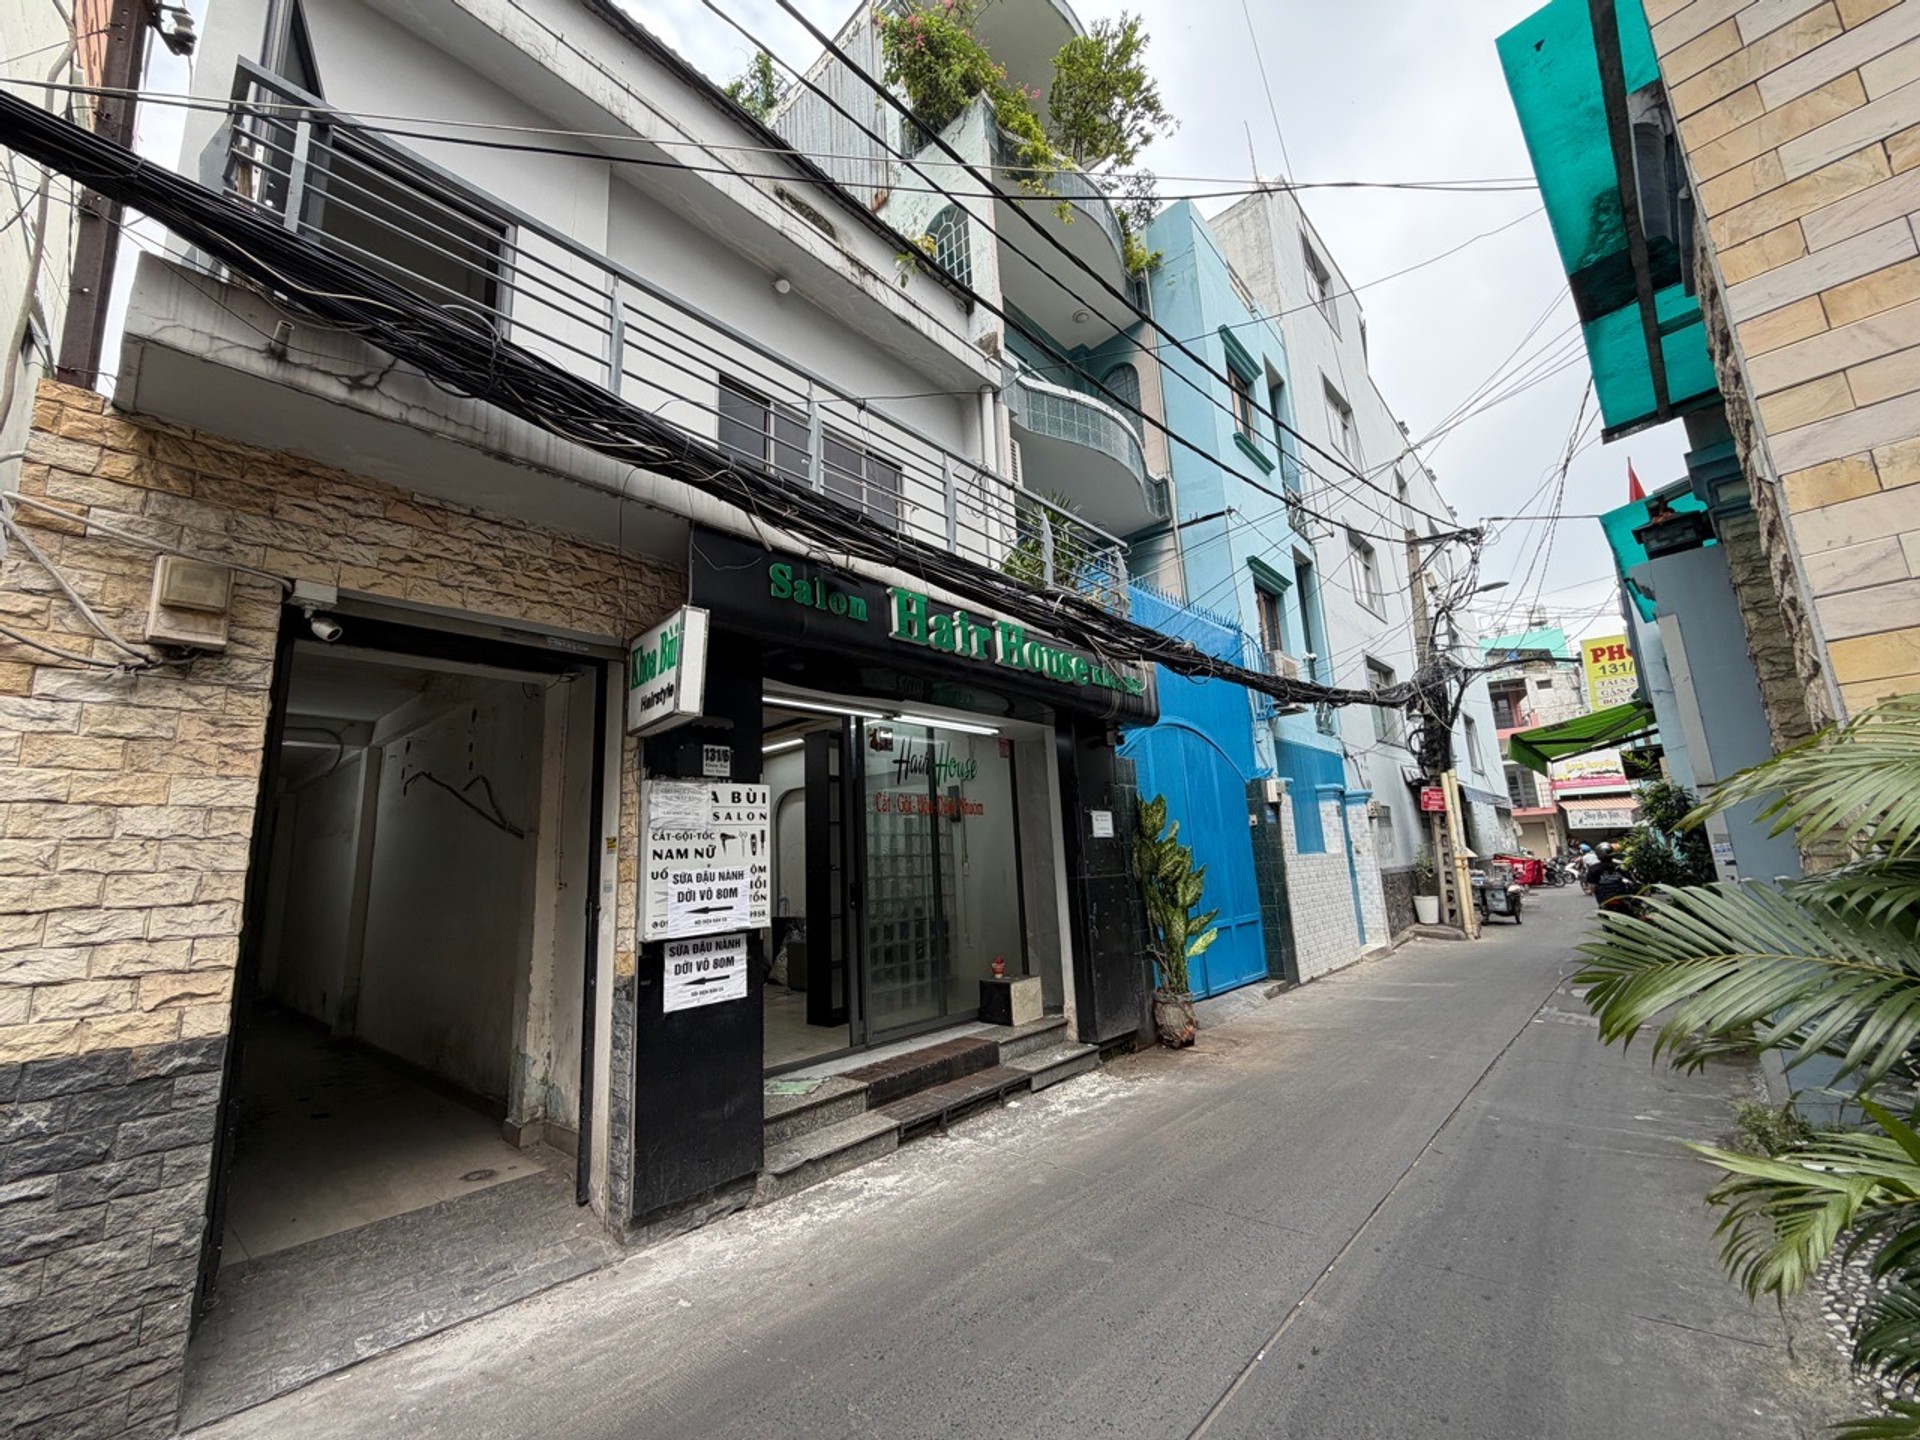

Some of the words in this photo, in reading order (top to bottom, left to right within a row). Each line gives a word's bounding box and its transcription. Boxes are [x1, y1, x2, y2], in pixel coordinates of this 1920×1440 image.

[769, 562, 868, 622] Salon
[887, 586, 991, 661] Hair
[992, 620, 1088, 686] House
[631, 644, 657, 690] Khoa
[659, 622, 679, 675] Bùi
[640, 682, 674, 712] Hairstyle
[892, 736, 930, 785] Hair
[932, 741, 978, 788] House
[731, 787, 767, 804] BÙI
[712, 811, 767, 821] SALON
[653, 848, 689, 860] NAM
[694, 844, 717, 859] NỮ
[672, 871, 693, 885] SỮA
[695, 869, 716, 885] ĐẬU
[718, 869, 745, 882] NÀNH
[677, 889, 696, 903] DỜI
[699, 887, 713, 901] VÔ
[716, 887, 738, 900] 80M
[669, 943, 690, 957] SỮA
[692, 941, 712, 956] ĐẬU
[715, 938, 741, 951] NÀNH
[674, 960, 693, 976] DỜI
[696, 957, 710, 972] VÔ
[712, 956, 735, 969] 80M
